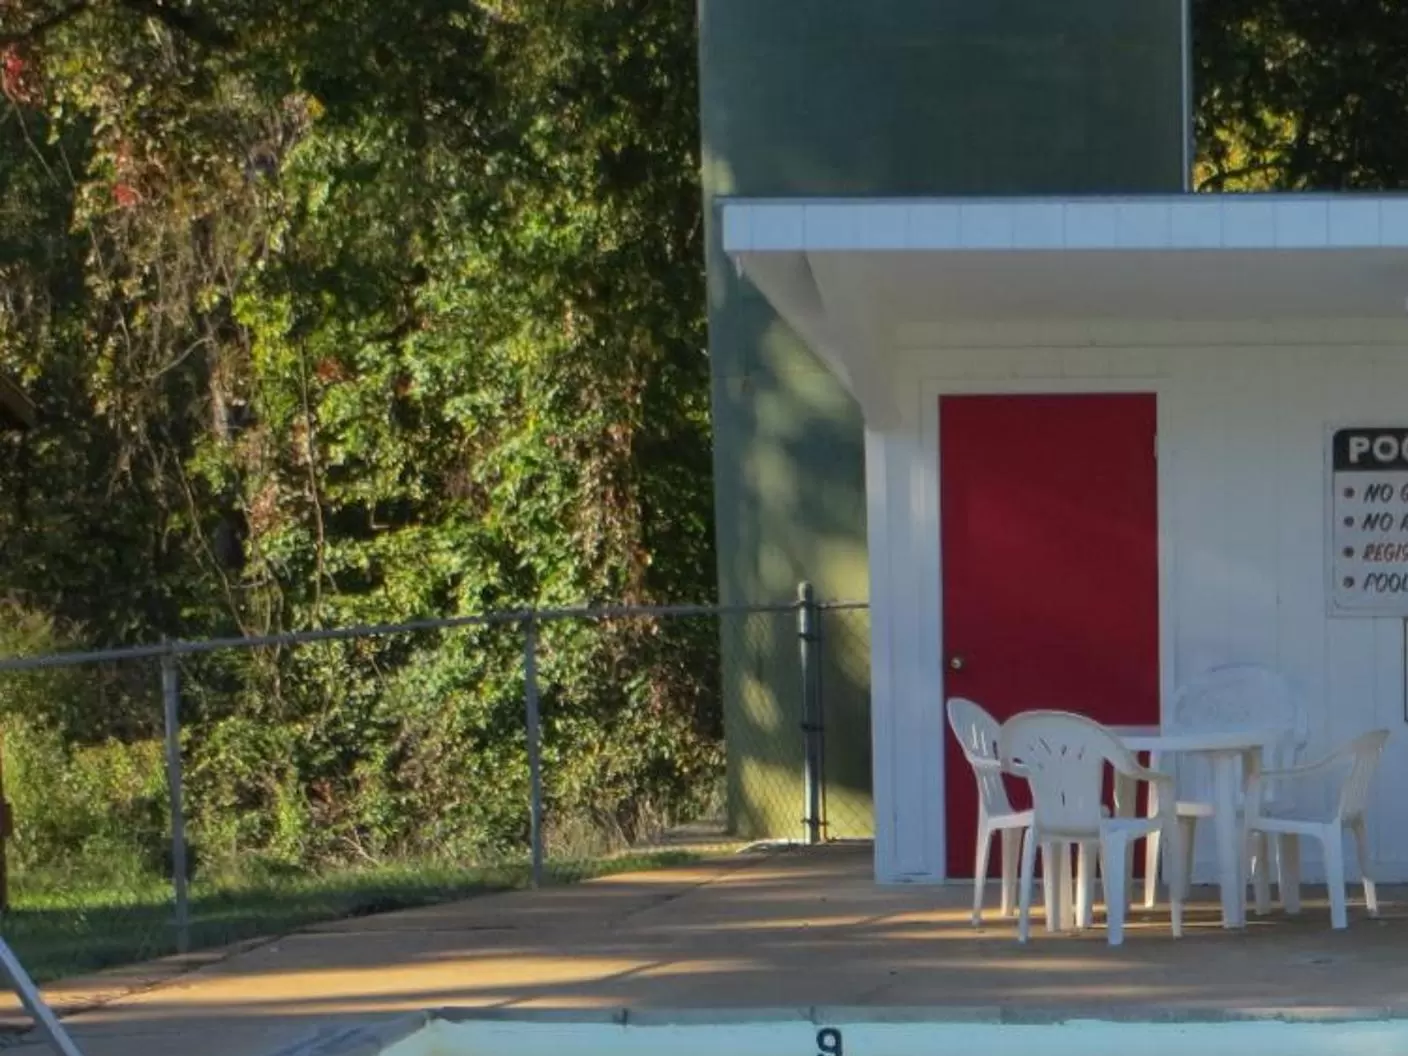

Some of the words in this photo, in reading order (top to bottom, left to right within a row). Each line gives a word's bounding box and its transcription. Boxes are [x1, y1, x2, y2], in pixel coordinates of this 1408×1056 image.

[1363, 483, 1394, 503] NO
[1361, 512, 1394, 532] NO
[1363, 572, 1408, 592] POOL
